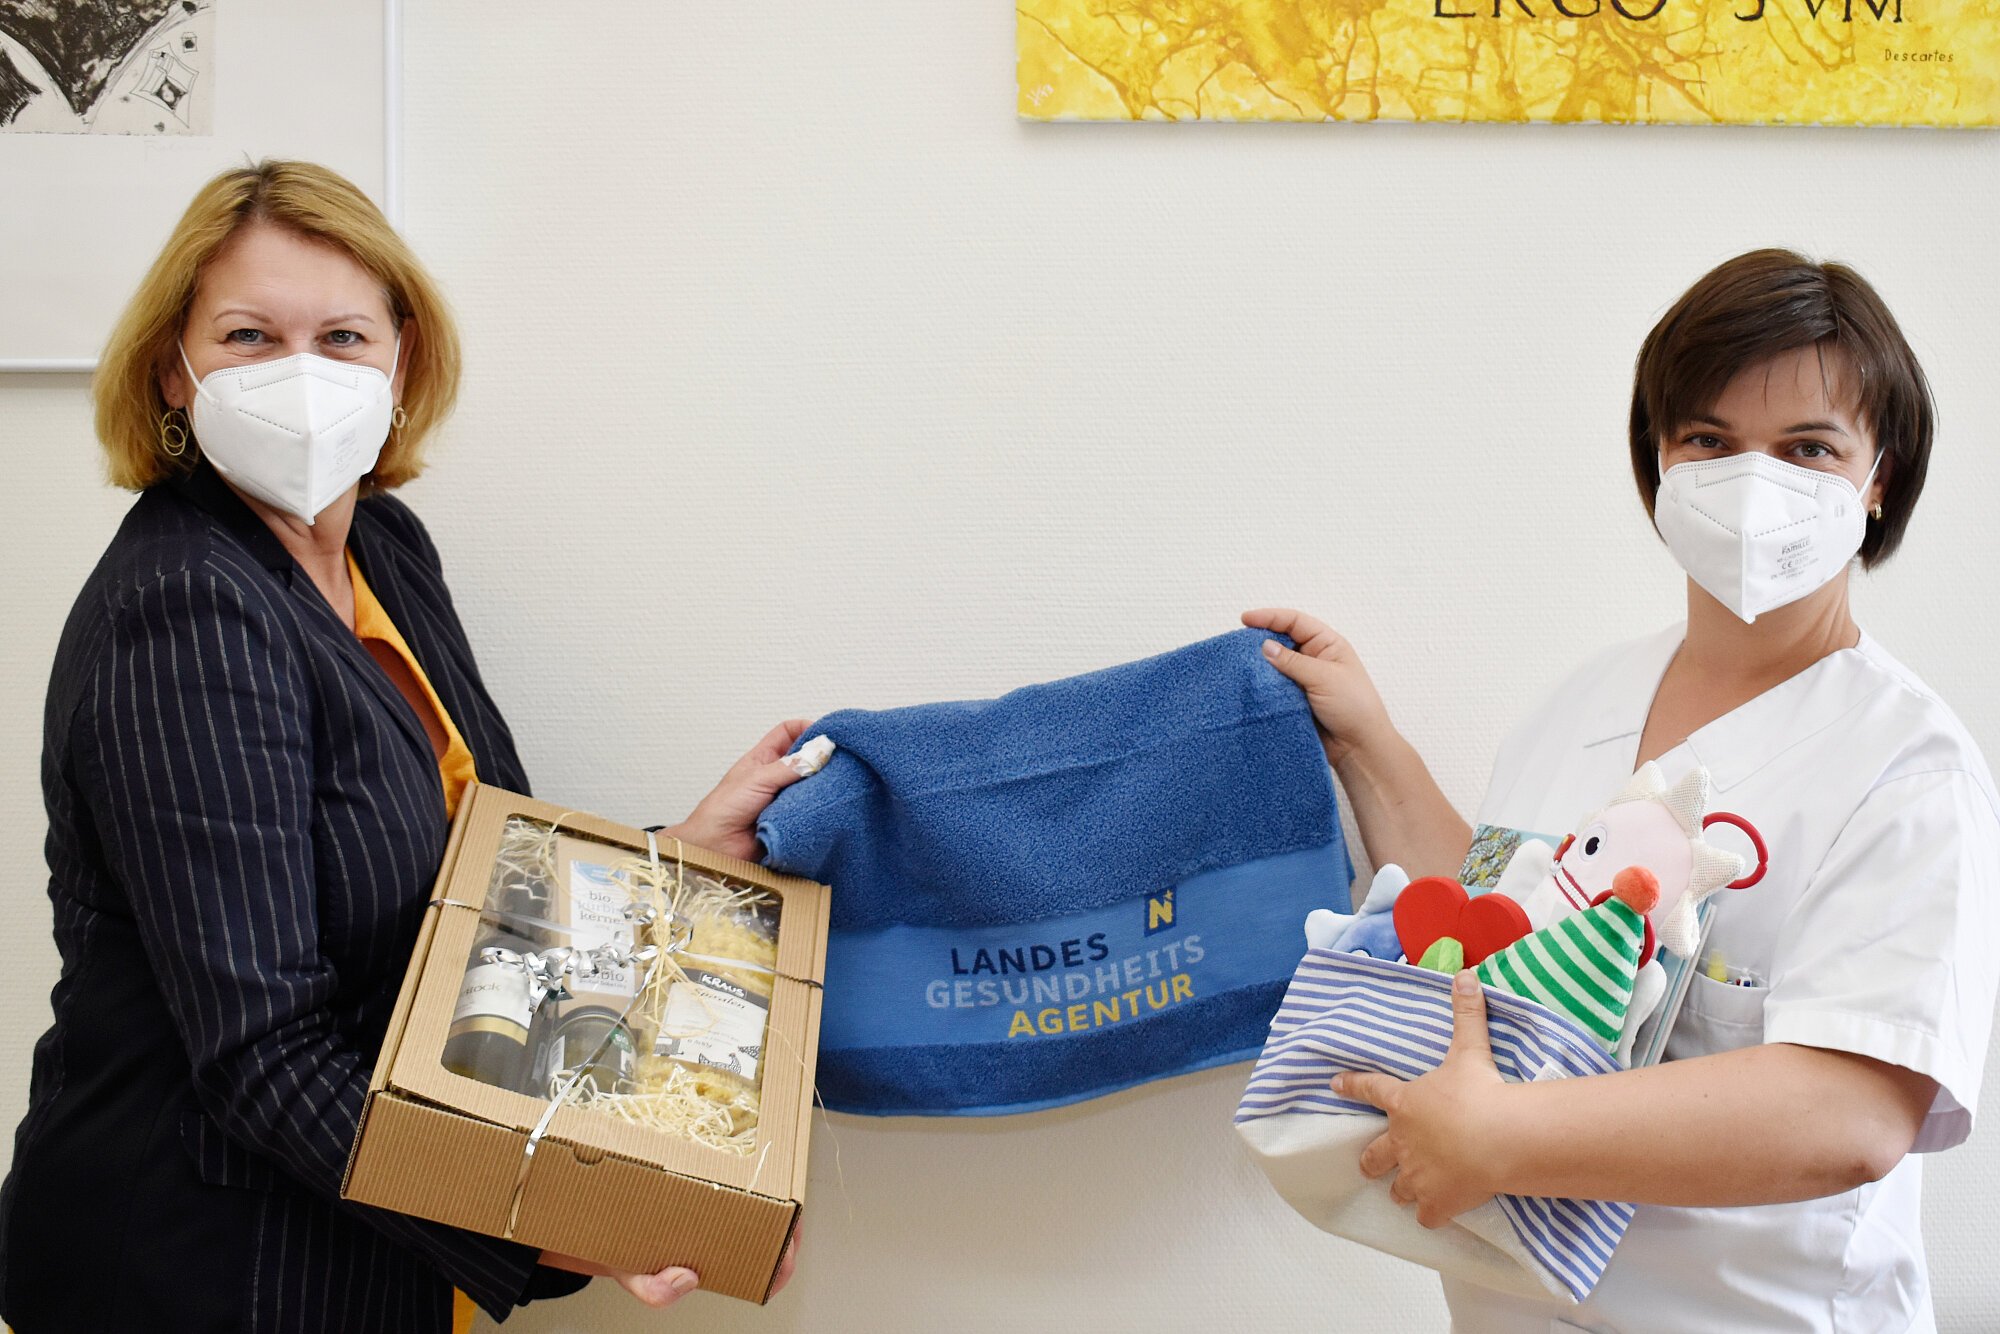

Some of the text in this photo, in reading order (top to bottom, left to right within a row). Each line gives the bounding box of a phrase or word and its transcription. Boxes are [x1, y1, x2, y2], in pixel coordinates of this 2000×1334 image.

[1884, 48, 1954, 63] Descartes
[926, 935, 1205, 1008] GESUNDHEITS
[951, 933, 1109, 975] LANDES
[701, 974, 745, 998] KRAUS
[1008, 973, 1194, 1038] AGENTUR
